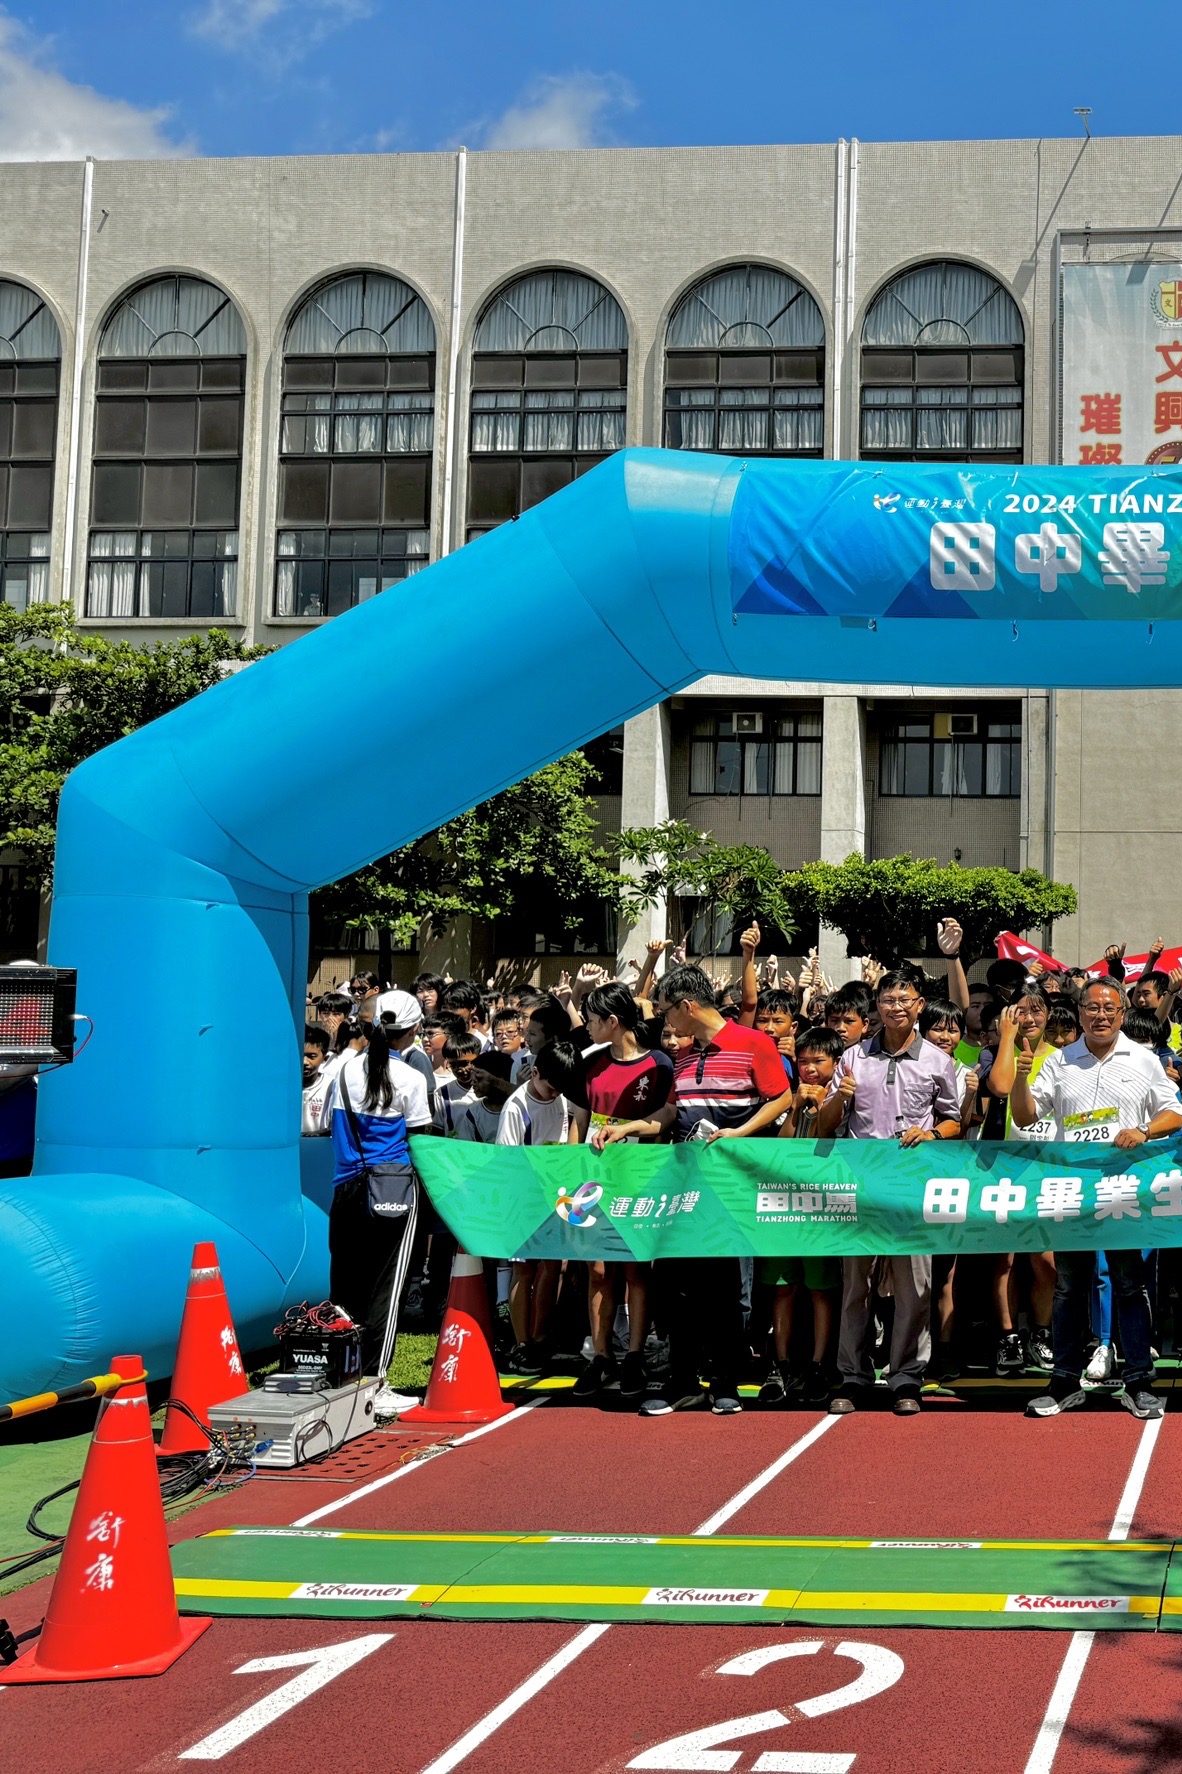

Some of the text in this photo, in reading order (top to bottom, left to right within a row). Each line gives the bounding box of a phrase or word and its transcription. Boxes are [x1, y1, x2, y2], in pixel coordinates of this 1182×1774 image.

[1004, 493, 1077, 514] 2024
[1074, 1126, 1110, 1142] 2228
[757, 1182, 858, 1191] TAIWAN'S RICE HEAVEN
[756, 1215, 858, 1223] TIANZHONG MARATHON
[293, 1353, 329, 1364] YUASA
[178, 1634, 396, 1760] 1
[625, 1640, 905, 1774] 2
